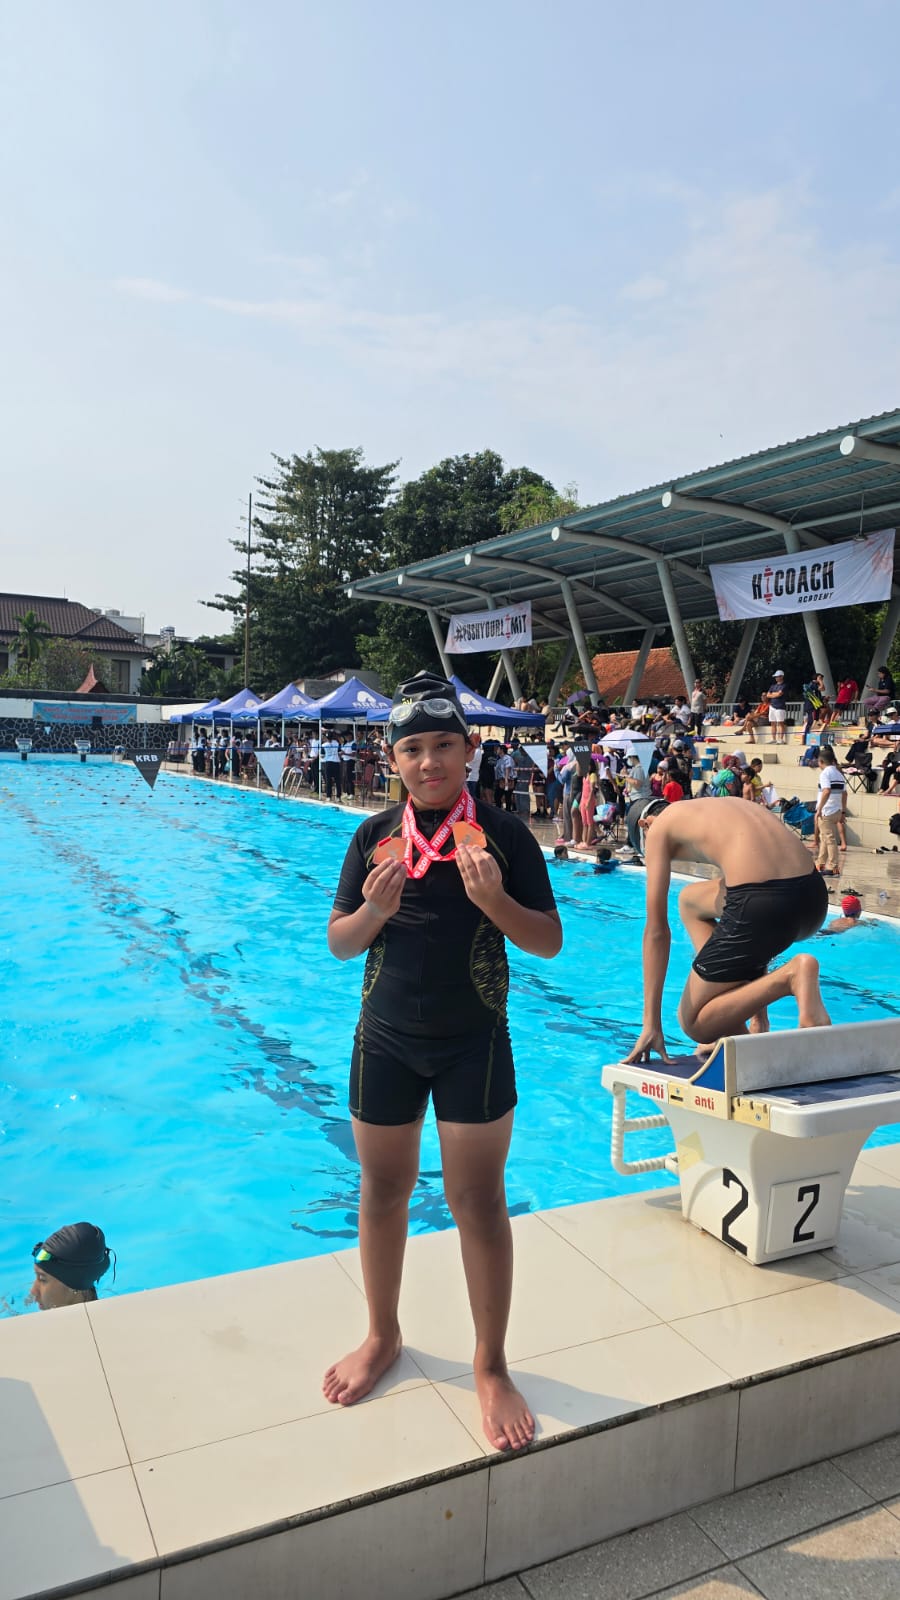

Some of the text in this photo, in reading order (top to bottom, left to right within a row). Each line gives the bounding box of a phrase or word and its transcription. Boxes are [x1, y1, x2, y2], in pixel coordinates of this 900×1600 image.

[641, 1082, 664, 1099] anti
[694, 1096, 714, 1111] anti
[722, 1168, 748, 1256] 2
[793, 1184, 820, 1243] 2
